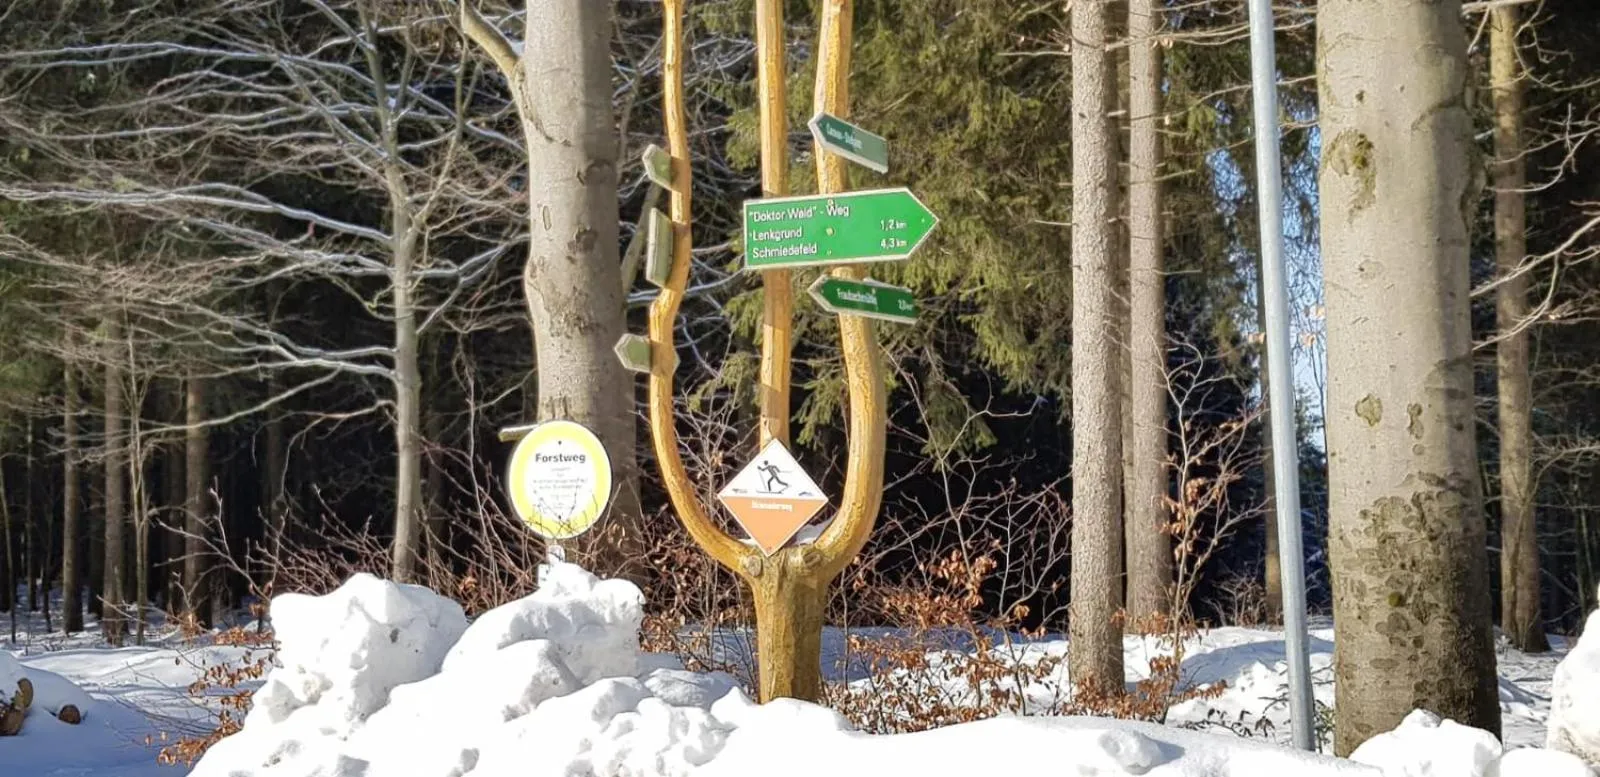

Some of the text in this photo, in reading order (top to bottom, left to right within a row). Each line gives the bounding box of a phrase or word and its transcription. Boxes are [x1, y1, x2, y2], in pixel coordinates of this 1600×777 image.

[826, 204, 850, 217] Weg
[752, 219, 907, 241] Lenkgrund 1,2 km
[752, 238, 907, 259] Schmiedefeld 4,3 km
[535, 453, 586, 464] Forstweg
